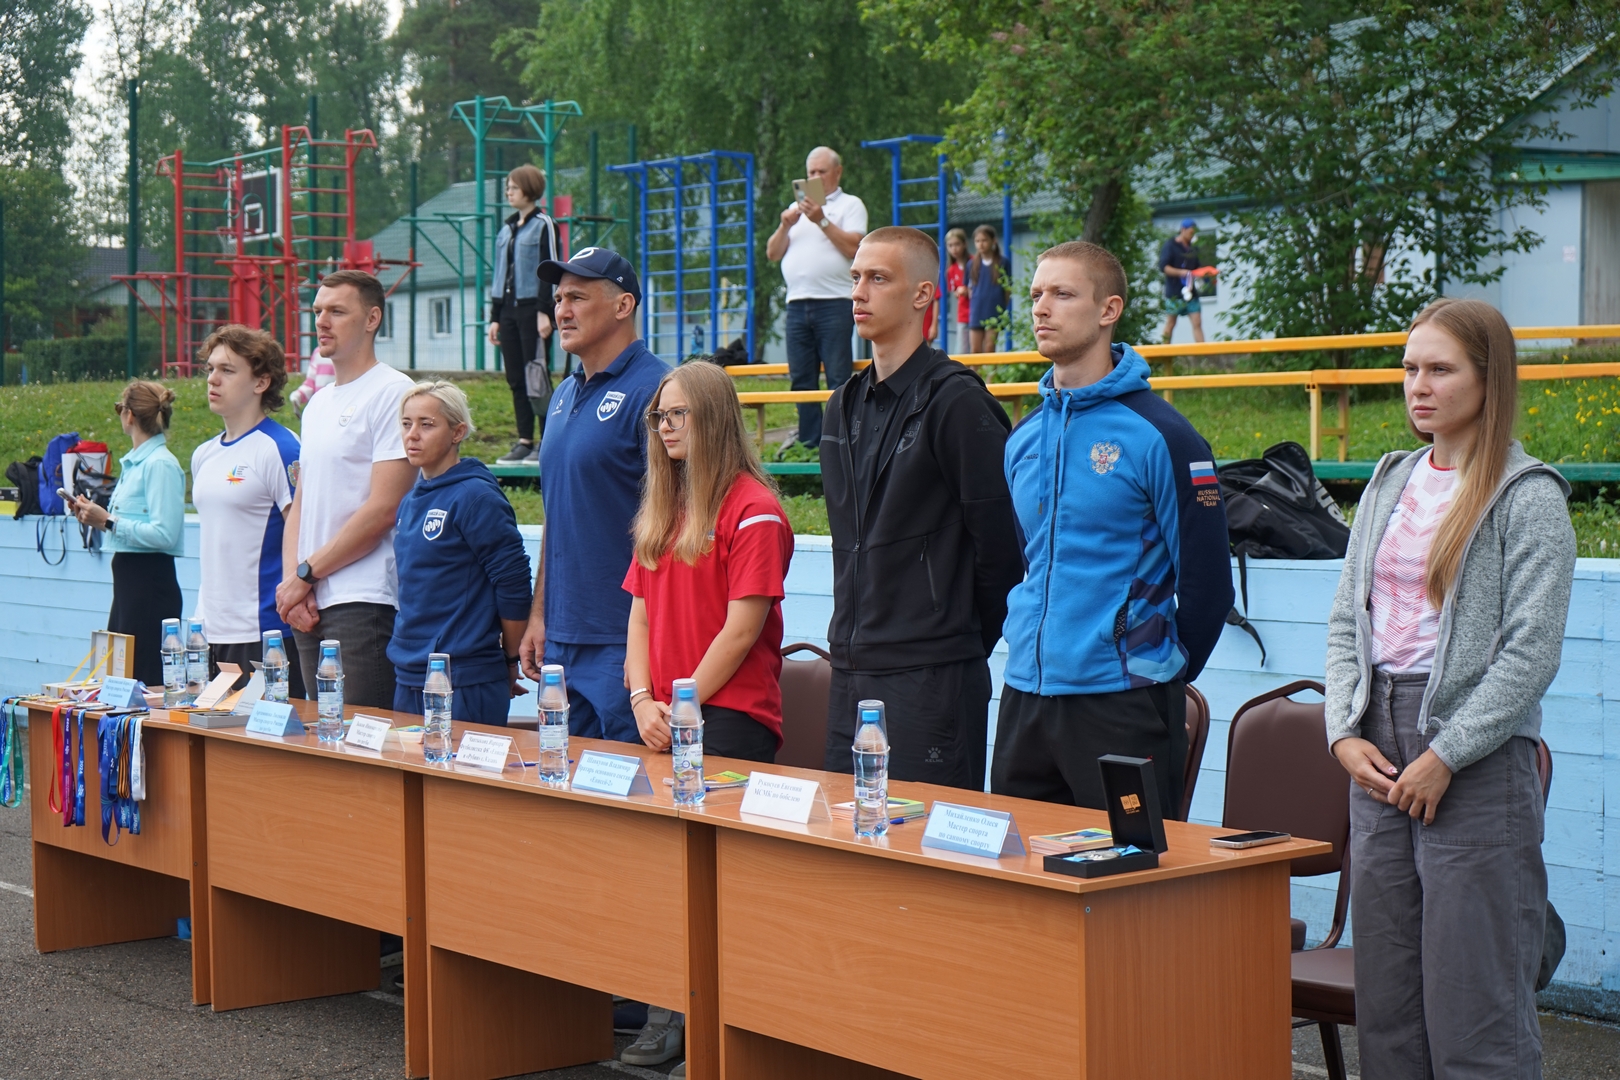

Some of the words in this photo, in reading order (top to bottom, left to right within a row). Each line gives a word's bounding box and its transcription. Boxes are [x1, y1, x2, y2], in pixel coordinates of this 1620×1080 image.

[595, 768, 616, 778] основного
[608, 761, 631, 772] Владимир
[780, 782, 802, 792] Евгений
[754, 788, 772, 798] МСМК
[778, 792, 800, 803] бобслею
[945, 809, 980, 824] Михайленко
[980, 817, 998, 828] Олеся
[946, 821, 968, 833] Мастер
[968, 828, 988, 837] спорта
[946, 834, 969, 846] санному
[970, 840, 990, 850] спорту
